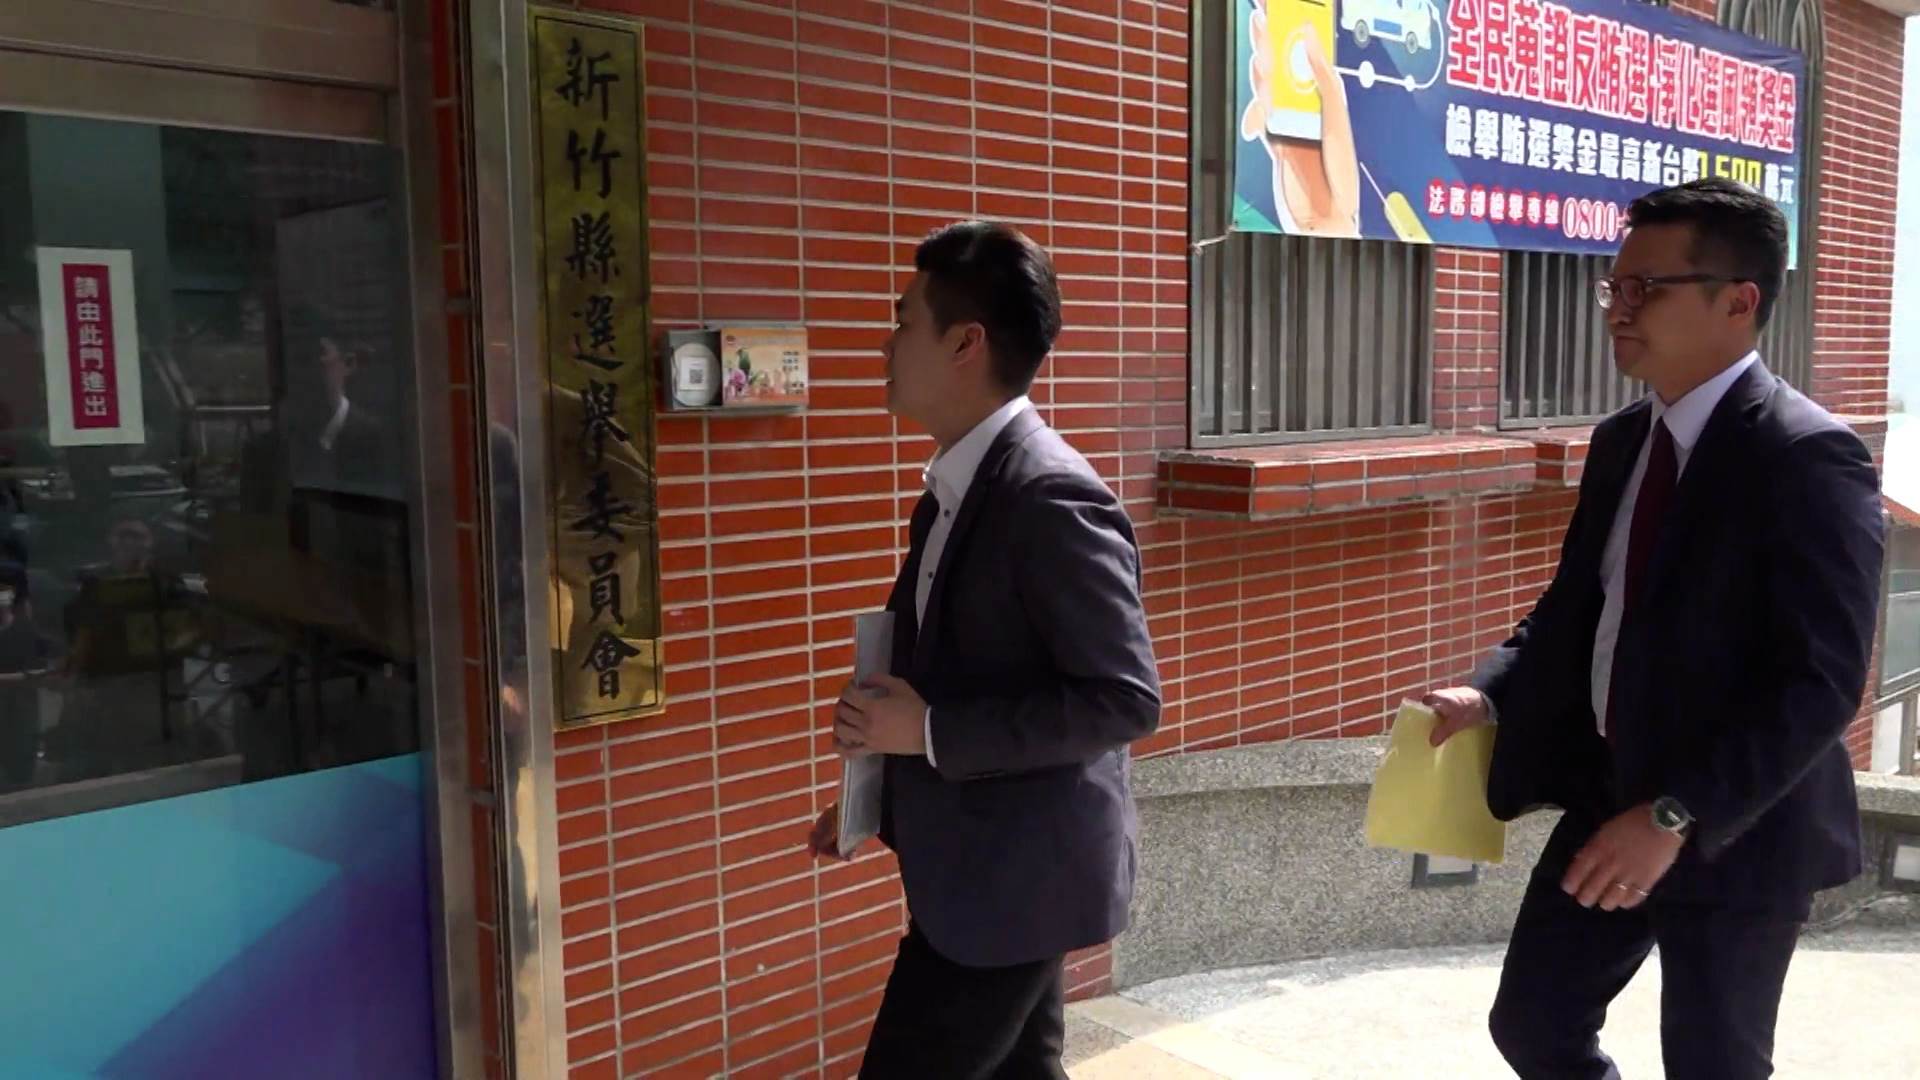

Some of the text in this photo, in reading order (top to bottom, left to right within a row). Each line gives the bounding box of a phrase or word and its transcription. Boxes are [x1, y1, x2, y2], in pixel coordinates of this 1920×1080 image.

[1562, 197, 1633, 243] 0800-
[74, 276, 108, 417] 請由此門進出
[555, 37, 641, 699] 新竹縣選舉委員會
